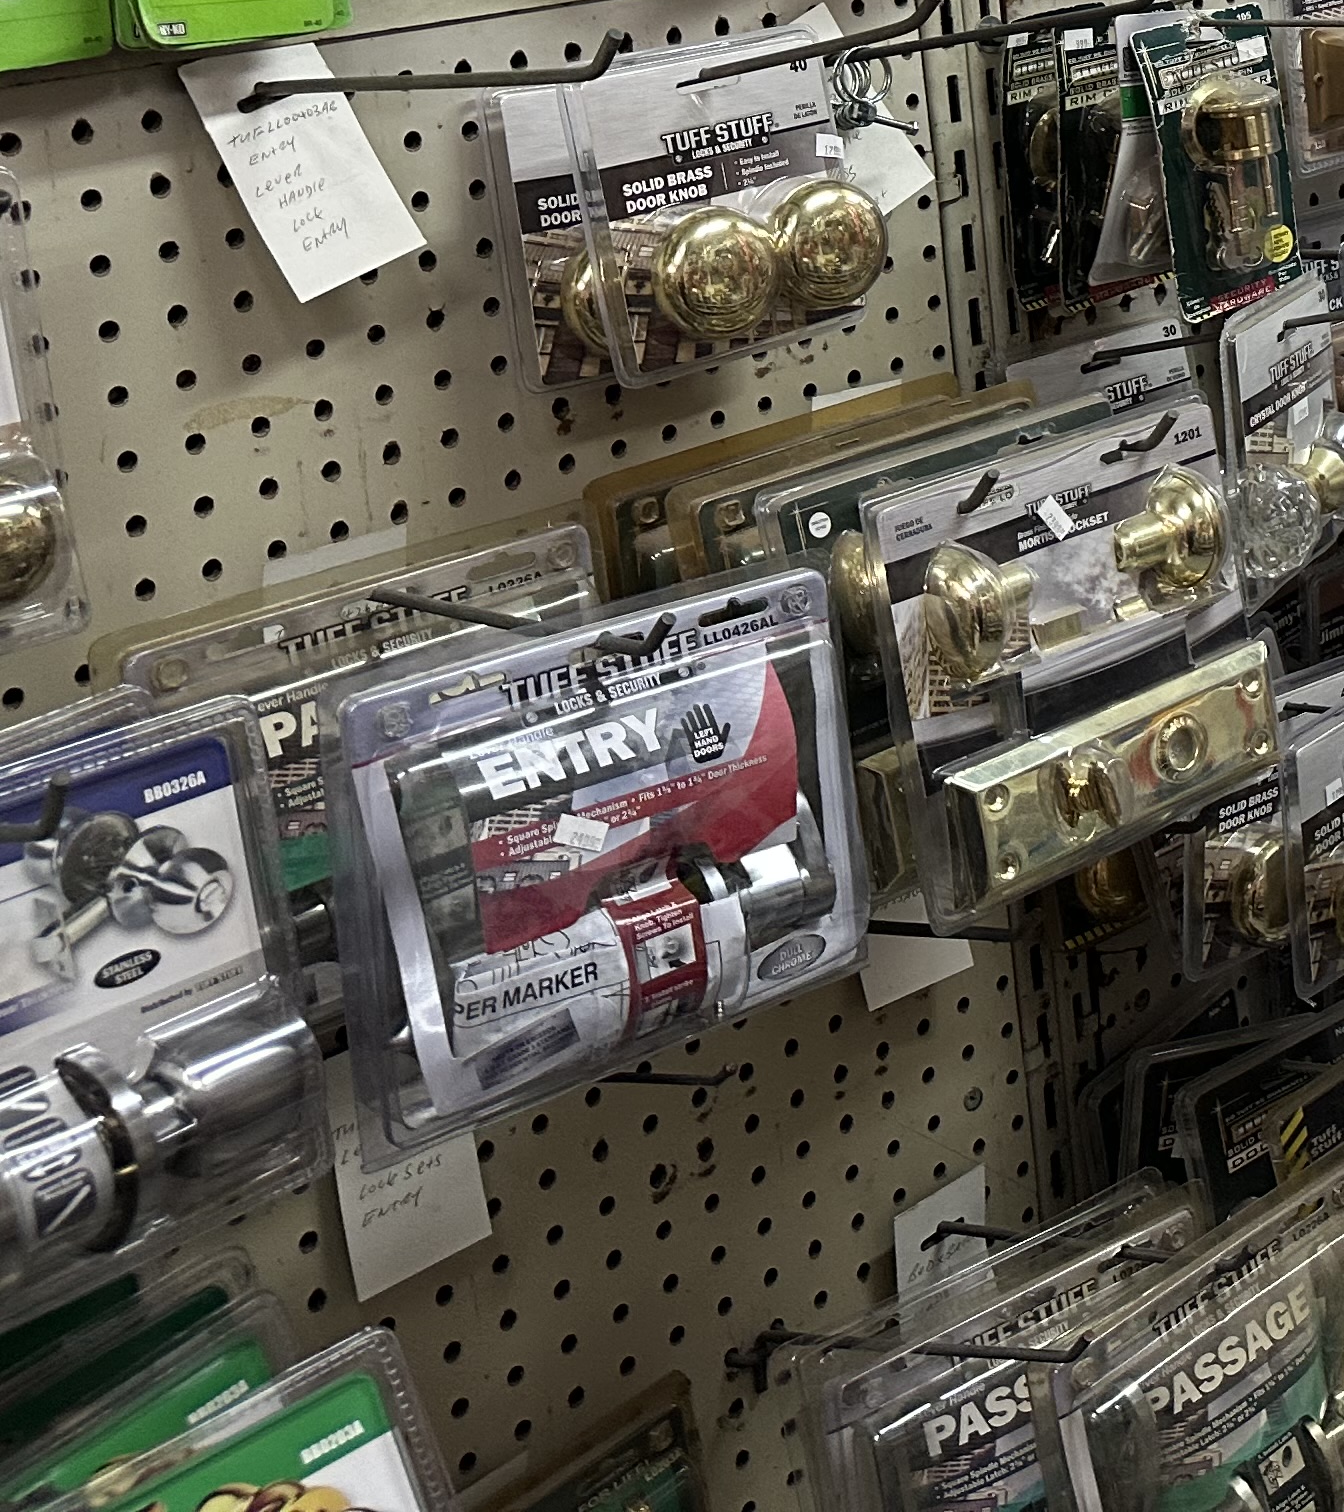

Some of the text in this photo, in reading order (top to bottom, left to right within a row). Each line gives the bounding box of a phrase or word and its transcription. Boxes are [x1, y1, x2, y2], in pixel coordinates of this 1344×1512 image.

[662, 112, 774, 154] TUFF STUFF
[622, 165, 713, 197] SOLID BRASS
[626, 184, 708, 214] DOOR KNOB
[1249, 404, 1275, 428] CRYSTAL
[1275, 393, 1291, 411] DOOR
[1174, 426, 1202, 446] 1201
[1057, 484, 1092, 505] STUFF
[703, 615, 779, 646] LL0426AL
[555, 673, 662, 715] LOCKS SECURITY
[694, 728, 714, 740] LEFT
[694, 736, 718, 749] HAND
[477, 707, 662, 801] ENTRY
[693, 742, 724, 758] DOORS
[728, 754, 768, 775] Thickness
[143, 772, 207, 805] BB0326A
[101, 953, 154, 980] STAINLESS
[771, 950, 813, 976] CHROME
[780, 945, 803, 963] DULL
[115, 966, 147, 986] STEEL
[502, 962, 598, 1009] MARKER
[1151, 1288, 1310, 1414] PASSAGE
